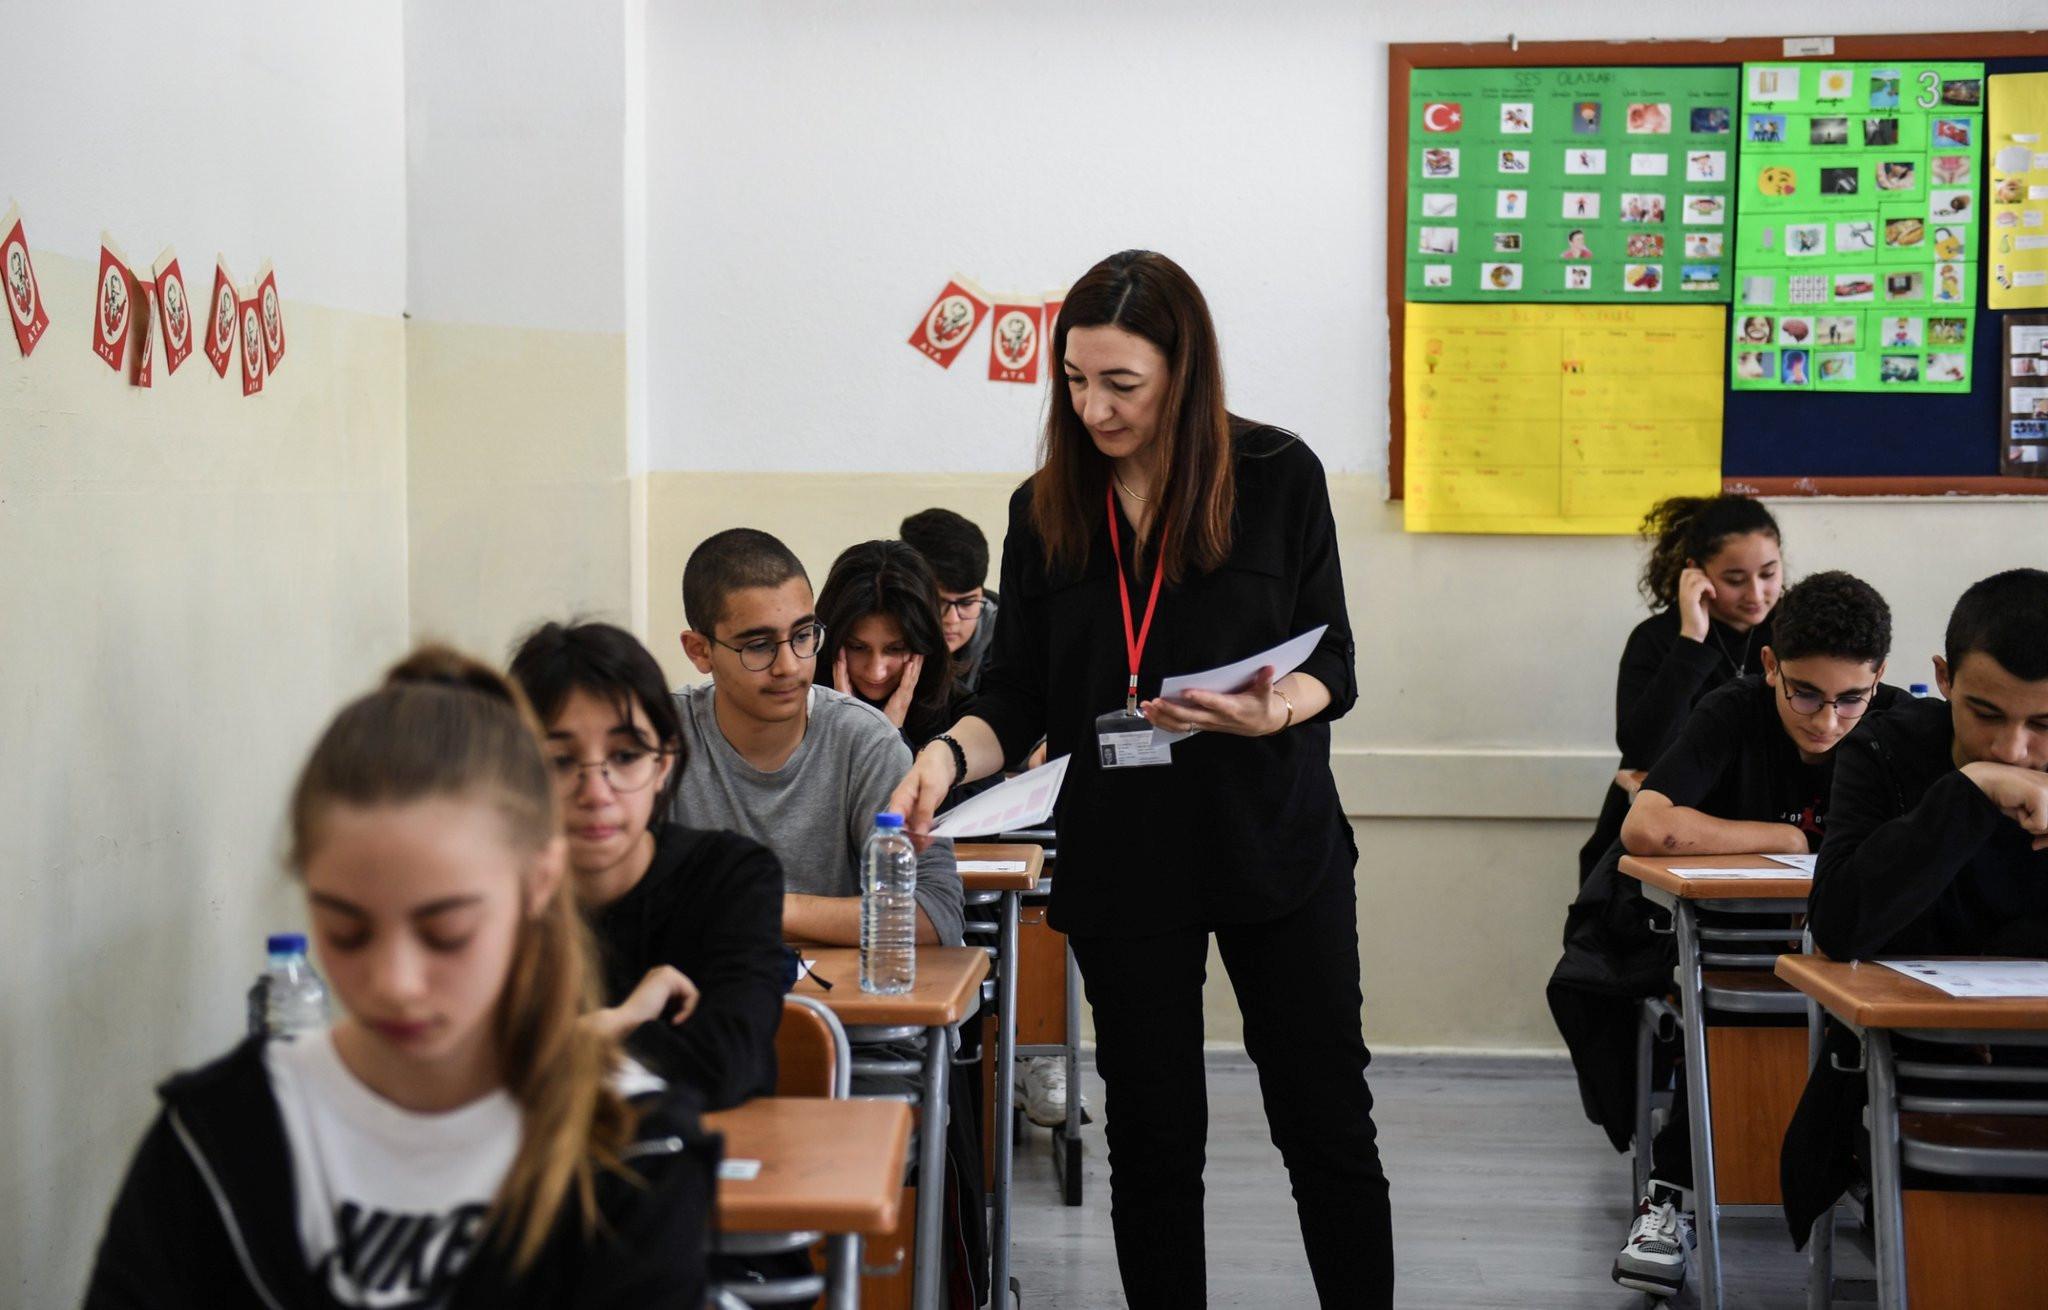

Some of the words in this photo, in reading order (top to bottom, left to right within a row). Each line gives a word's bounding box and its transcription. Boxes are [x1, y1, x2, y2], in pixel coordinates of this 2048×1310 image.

[1916, 70, 1942, 109] 3
[27, 320, 43, 344] ATA
[99, 343, 114, 363] ATA
[174, 348, 187, 366] ATA
[211, 347, 223, 367] ATA
[919, 342, 942, 361] ATA
[1000, 371, 1025, 379] ATA
[336, 1202, 492, 1293] NIKE
